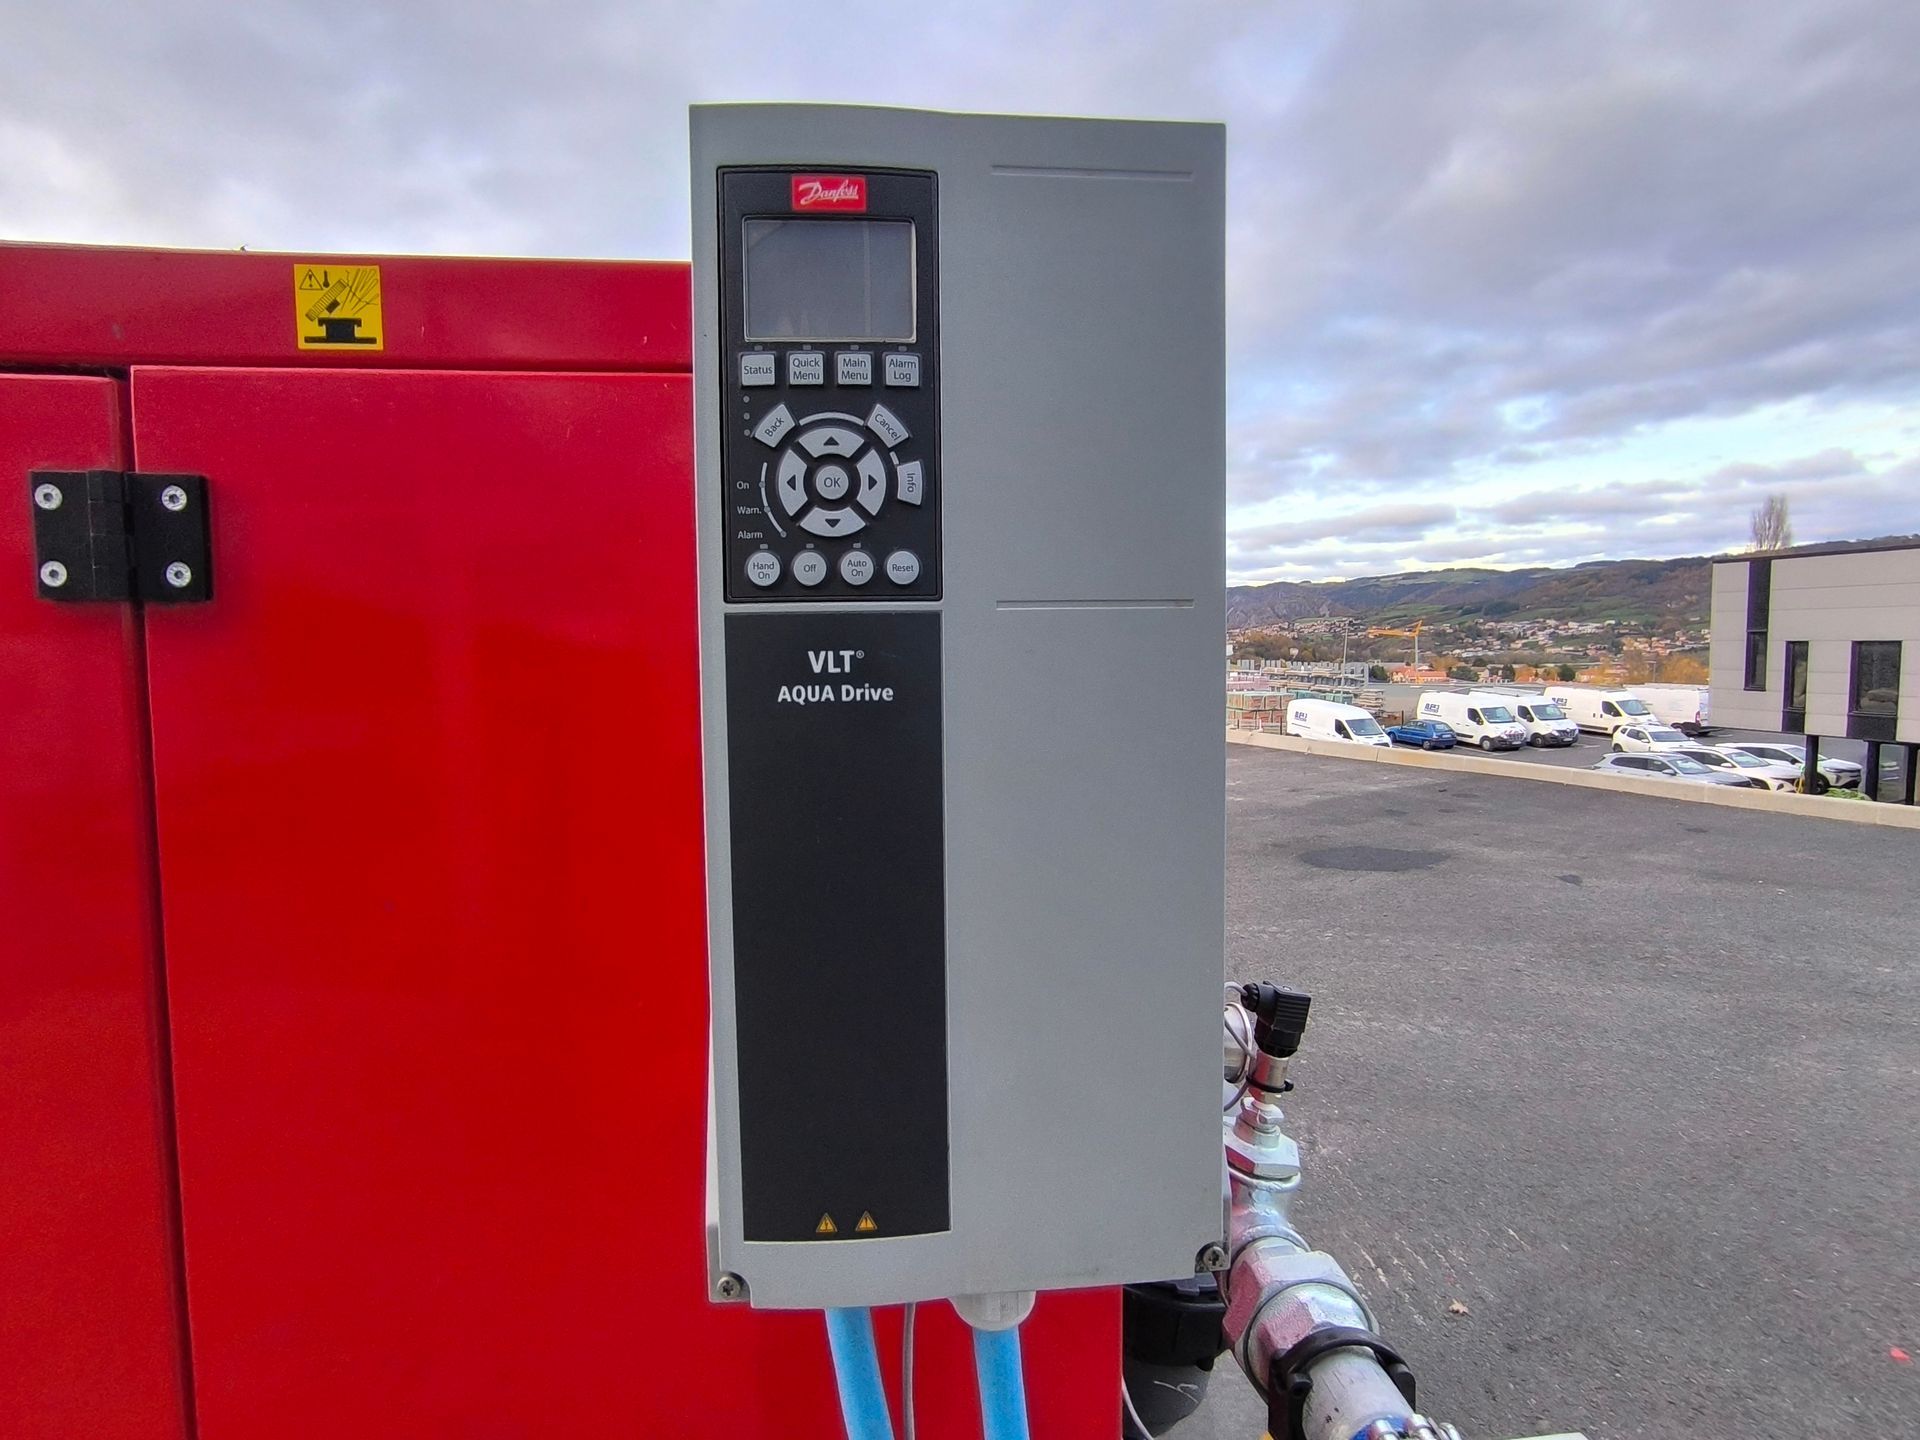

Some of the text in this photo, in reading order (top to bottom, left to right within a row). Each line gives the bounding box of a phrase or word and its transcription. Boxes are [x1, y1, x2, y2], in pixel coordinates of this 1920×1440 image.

[799, 179, 858, 205] Danfoss
[792, 358, 820, 369] Quick
[843, 358, 867, 368] Main
[889, 359, 916, 369] Alarm
[744, 365, 773, 375] Status
[841, 370, 868, 380] Menu
[793, 371, 820, 380] Menu
[893, 370, 912, 382] Log
[764, 417, 785, 437] Back
[874, 413, 902, 441] Cancel
[737, 481, 750, 490] On
[823, 477, 841, 488] OK
[906, 472, 915, 493] Info
[737, 506, 762, 515] Warn.
[738, 530, 763, 539] Alarm
[753, 561, 775, 570] Hand
[803, 564, 817, 573] Off
[847, 559, 867, 568] Auto
[892, 564, 914, 572] Reset
[758, 571, 771, 580] On
[851, 568, 864, 577] On
[777, 683, 894, 705] AQUA Drive
